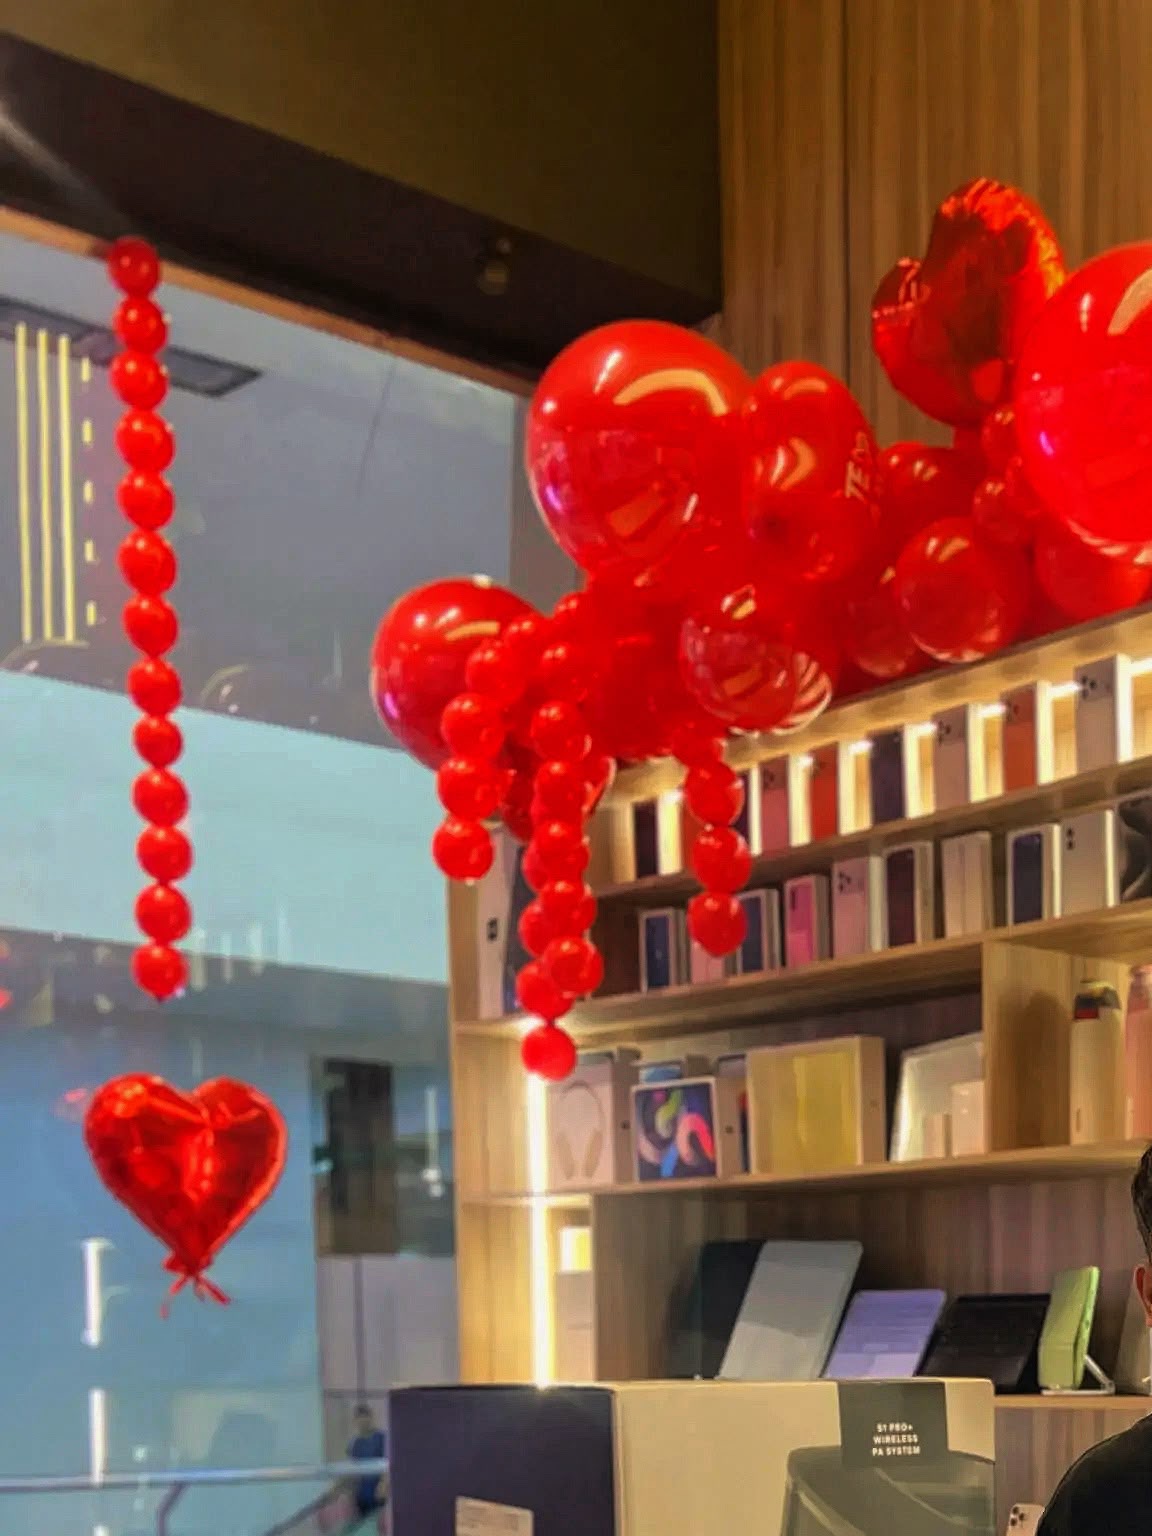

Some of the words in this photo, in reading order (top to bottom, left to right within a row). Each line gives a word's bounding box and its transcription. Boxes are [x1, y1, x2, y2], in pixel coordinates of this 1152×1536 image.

[873, 1434, 918, 1445] WIRELESS
[872, 1447, 884, 1457] PA
[886, 1446, 920, 1456] SYSTEM
